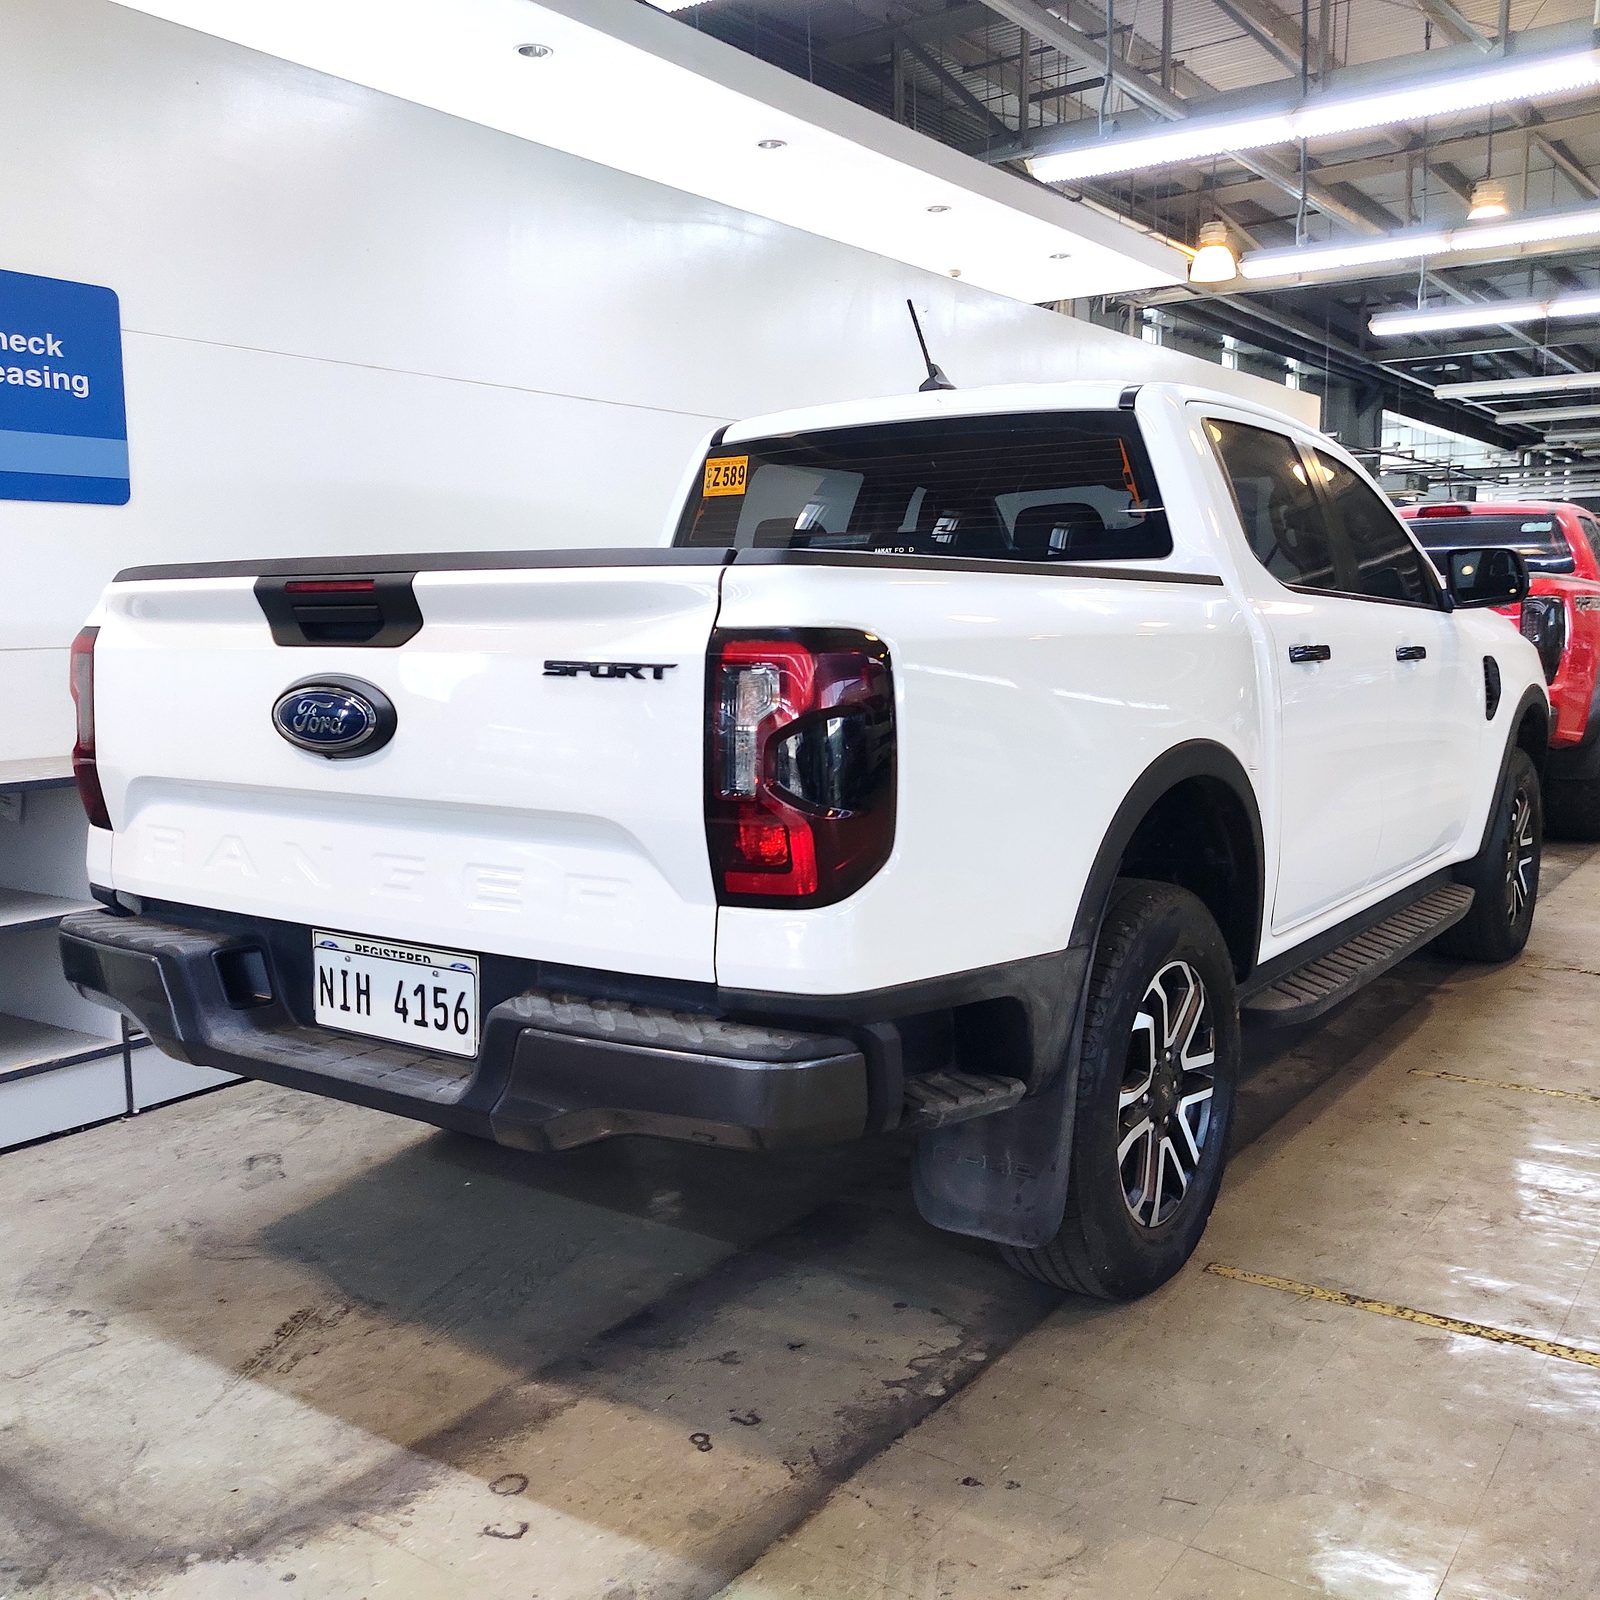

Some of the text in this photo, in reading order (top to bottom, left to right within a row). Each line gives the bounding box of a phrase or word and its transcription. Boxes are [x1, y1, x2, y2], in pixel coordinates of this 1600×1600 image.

[542, 660, 678, 680] SPORT
[293, 699, 347, 734] Ford
[319, 965, 469, 1035] NIH 4156
